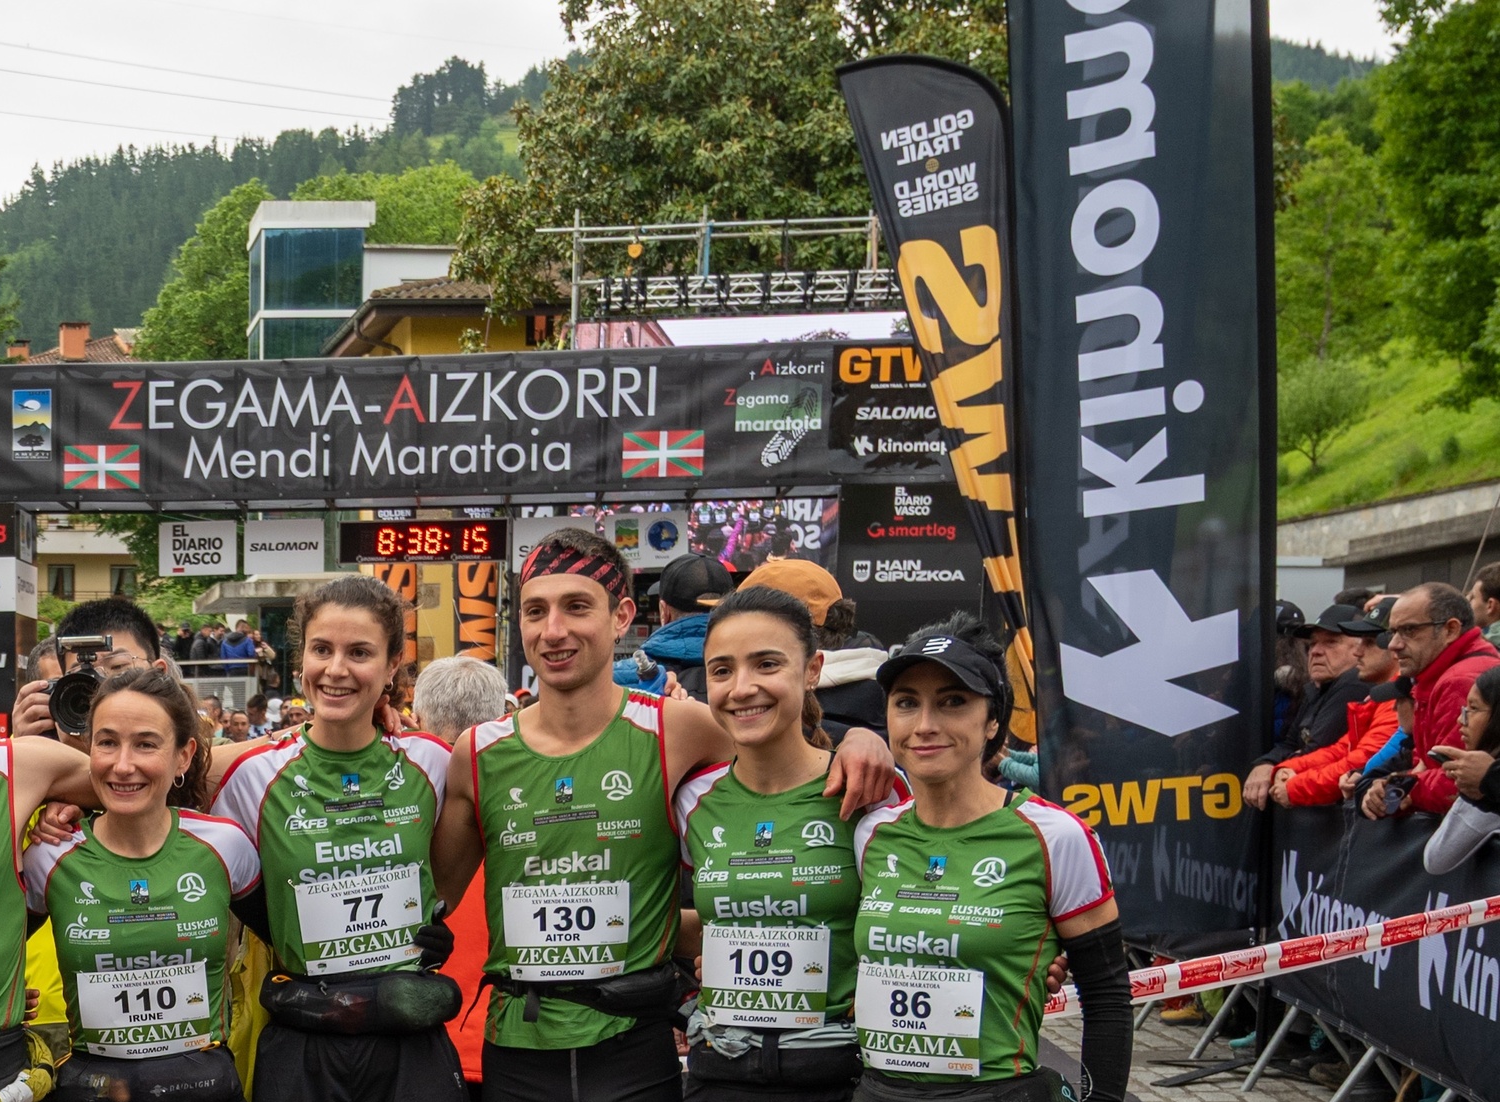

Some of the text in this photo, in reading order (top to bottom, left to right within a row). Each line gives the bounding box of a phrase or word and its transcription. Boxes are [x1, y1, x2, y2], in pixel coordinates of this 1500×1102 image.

[760, 358, 825, 376] Aizkorri
[110, 366, 657, 431] ZEGAMA-AIZKORRI
[724, 389, 789, 408] Zegama
[734, 415, 822, 432] maratoia
[184, 427, 572, 480] Mendi Maratoia
[895, 487, 907, 495] EL
[895, 496, 932, 506] DIARIO
[895, 506, 930, 516] VASCO
[172, 525, 189, 537] EL
[889, 524, 956, 539] smartlog
[172, 538, 223, 551] DIARIO
[250, 541, 319, 552] SALOMON
[377, 527, 488, 555] 8:38:15
[173, 552, 221, 565] VASCO
[876, 560, 922, 570] HAIN
[875, 571, 965, 582] GIPUZKOA
[597, 819, 641, 830] EUSKADI
[315, 833, 403, 863] Euskal
[525, 849, 610, 876] Euskal
[308, 870, 411, 895] ZEGAMA-AIZKORRI
[512, 887, 618, 899] ZEGAMA-AIZKORRI
[343, 893, 383, 922] 77
[714, 894, 807, 918] Euskal
[899, 906, 942, 914] SCARPA
[951, 905, 1003, 916] EUSKADI
[345, 919, 387, 933] AINHOA
[533, 906, 596, 931] 130
[545, 934, 580, 942] AITOR
[711, 929, 818, 941] ZEGAMA-AIZKORRI
[868, 926, 959, 957] Euskal
[319, 928, 416, 959] ZEGAMA
[349, 955, 391, 967] SALOMON
[517, 946, 615, 964] ZEGAMA
[729, 949, 792, 976] 109
[90, 965, 196, 984] ZEGAMA-AIZKORRI
[734, 977, 782, 986] ITSASNE
[866, 965, 971, 983] ZEGAMA-AIZKORRI
[114, 986, 176, 1013] 110
[711, 990, 811, 1011] ZEGAMA
[890, 990, 931, 1019] 86
[129, 1012, 163, 1022] IRUNE
[892, 1019, 927, 1030] SONIA
[98, 1022, 198, 1045] ZEGAMA
[127, 1045, 168, 1055] SALOMON
[865, 1031, 964, 1057] ZEGAMA
[885, 1058, 930, 1068] SALOMON
